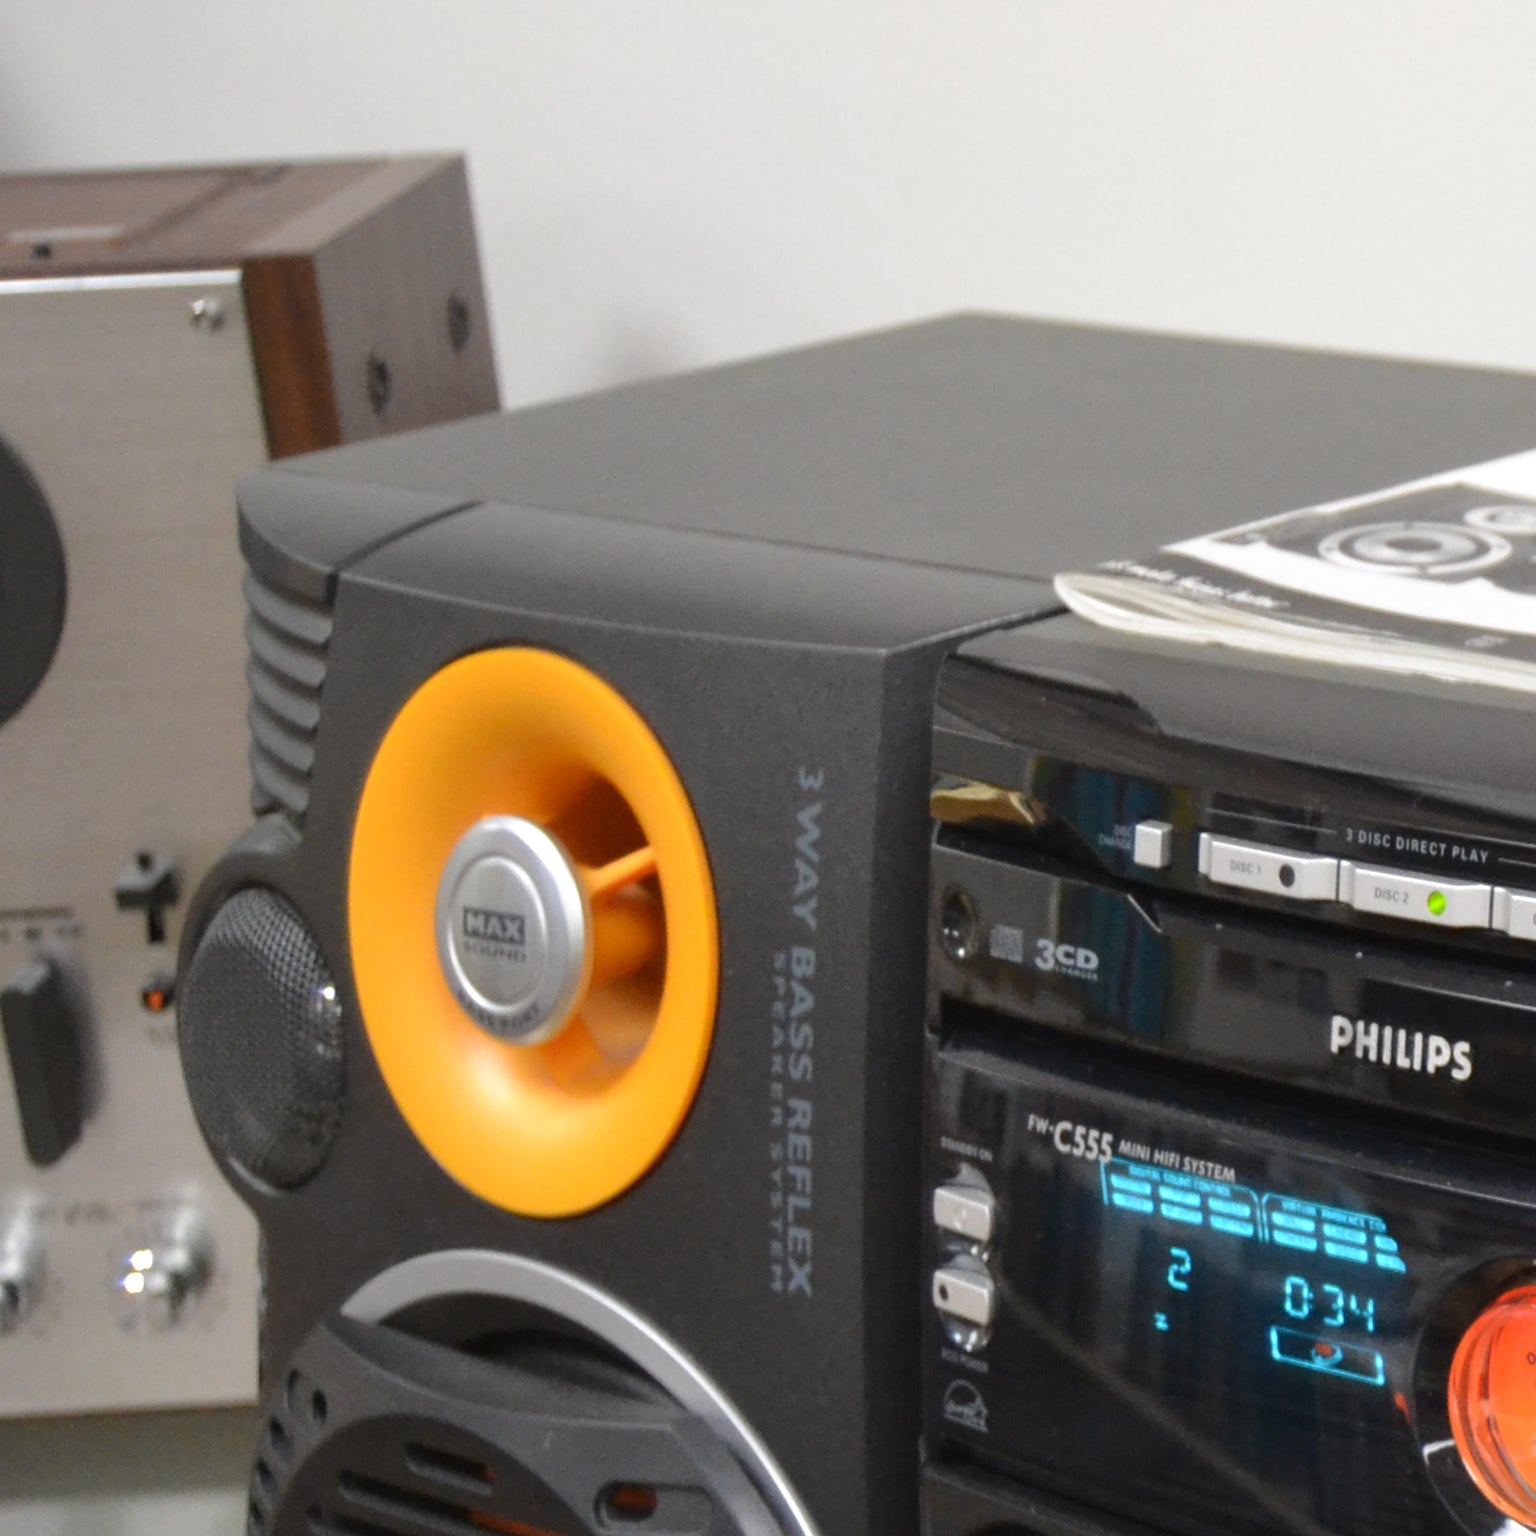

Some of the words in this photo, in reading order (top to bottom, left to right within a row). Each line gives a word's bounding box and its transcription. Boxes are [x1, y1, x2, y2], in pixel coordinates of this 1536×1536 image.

[793, 802, 822, 932] WAY
[1230, 859, 1253, 876] DISC
[1346, 828, 1354, 843] 3
[1358, 830, 1391, 848] DISC
[1396, 835, 1447, 858] DIRECT
[1452, 845, 1489, 864] PLAY
[1374, 886, 1401, 902] DISC
[1402, 892, 1410, 904] 2
[463, 908, 525, 945] MAX
[787, 946, 816, 1082] BASS
[1330, 1014, 1472, 1082] PHILIPS
[1118, 1138, 1151, 1161] MINI
[1153, 1148, 1181, 1172] HIFI
[1182, 1155, 1237, 1183] SYSTEM
[786, 1098, 812, 1297] REFLEX
[1167, 1246, 1192, 1292] 2
